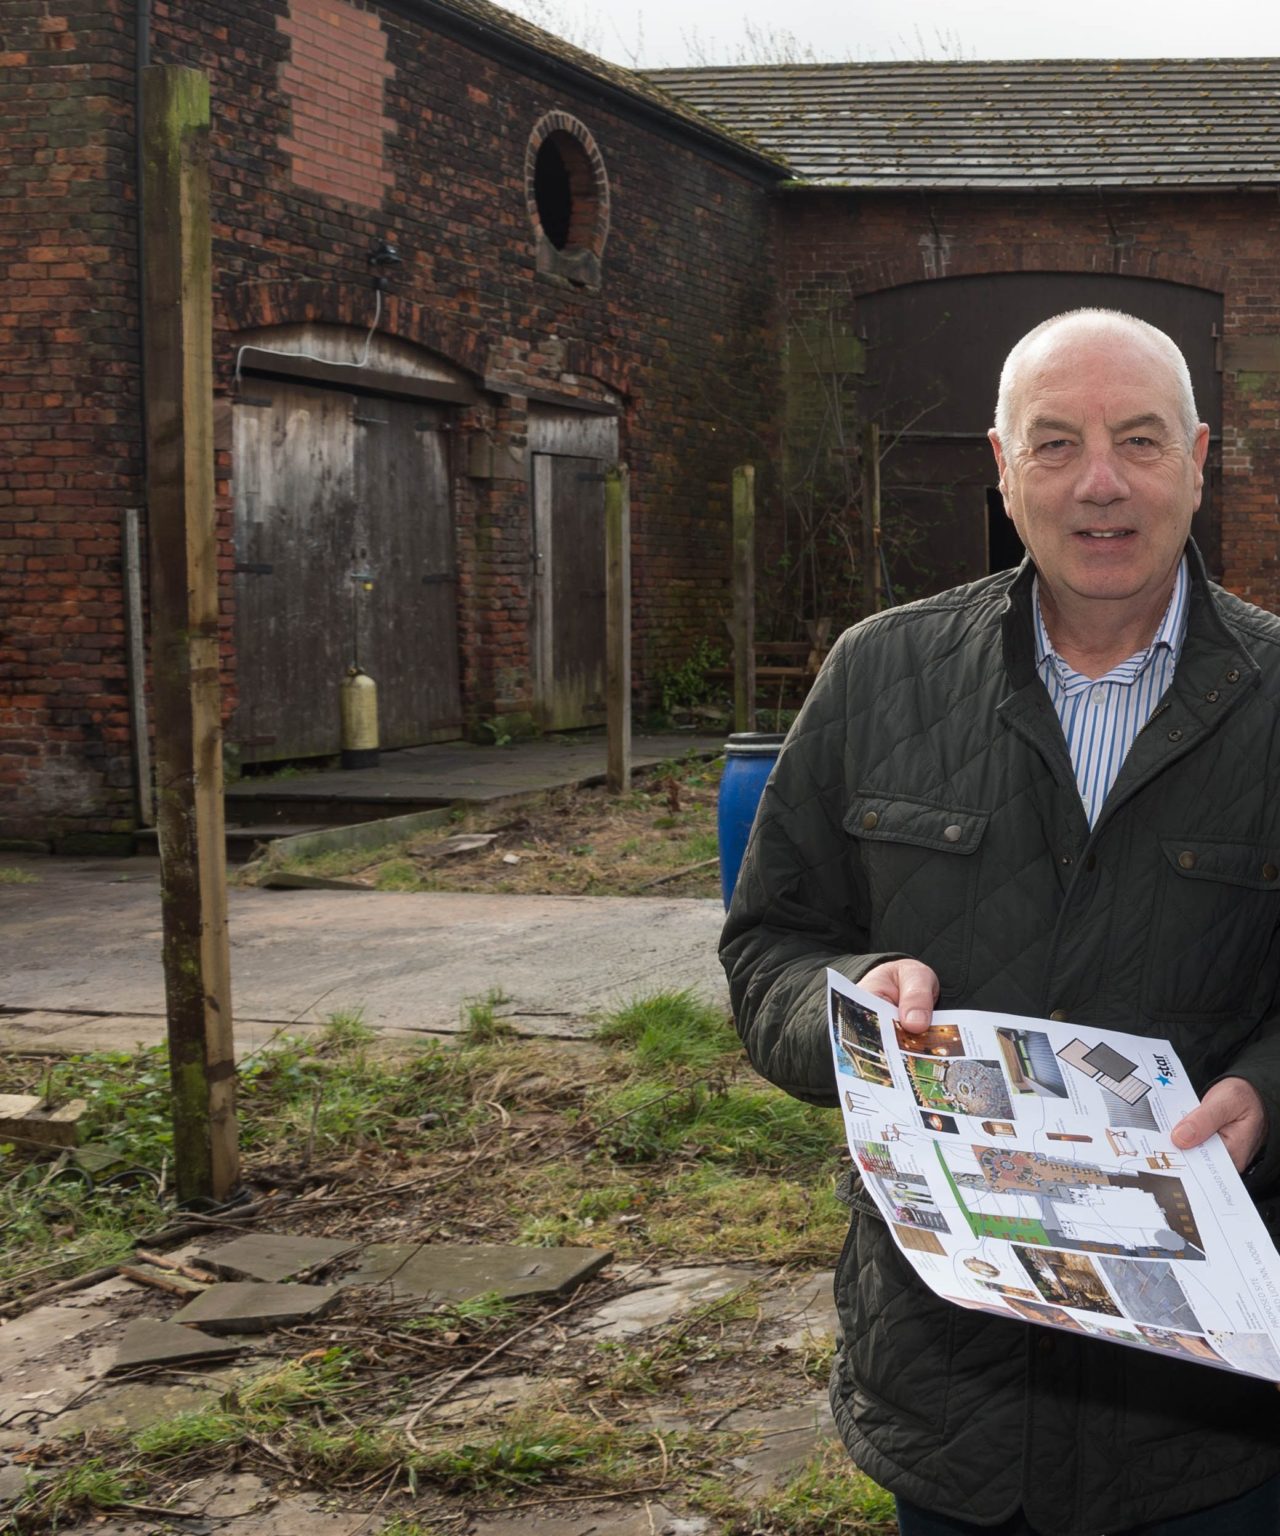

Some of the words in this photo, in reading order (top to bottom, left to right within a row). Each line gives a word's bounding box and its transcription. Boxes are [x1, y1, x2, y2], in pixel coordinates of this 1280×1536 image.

[1152, 1053, 1173, 1077] star
[1213, 1175, 1235, 1206] PROPOSED
[1245, 1240, 1262, 1265] MOORE
[1265, 1281, 1279, 1297] LION
[1258, 1293, 1280, 1328] PROPOSED
